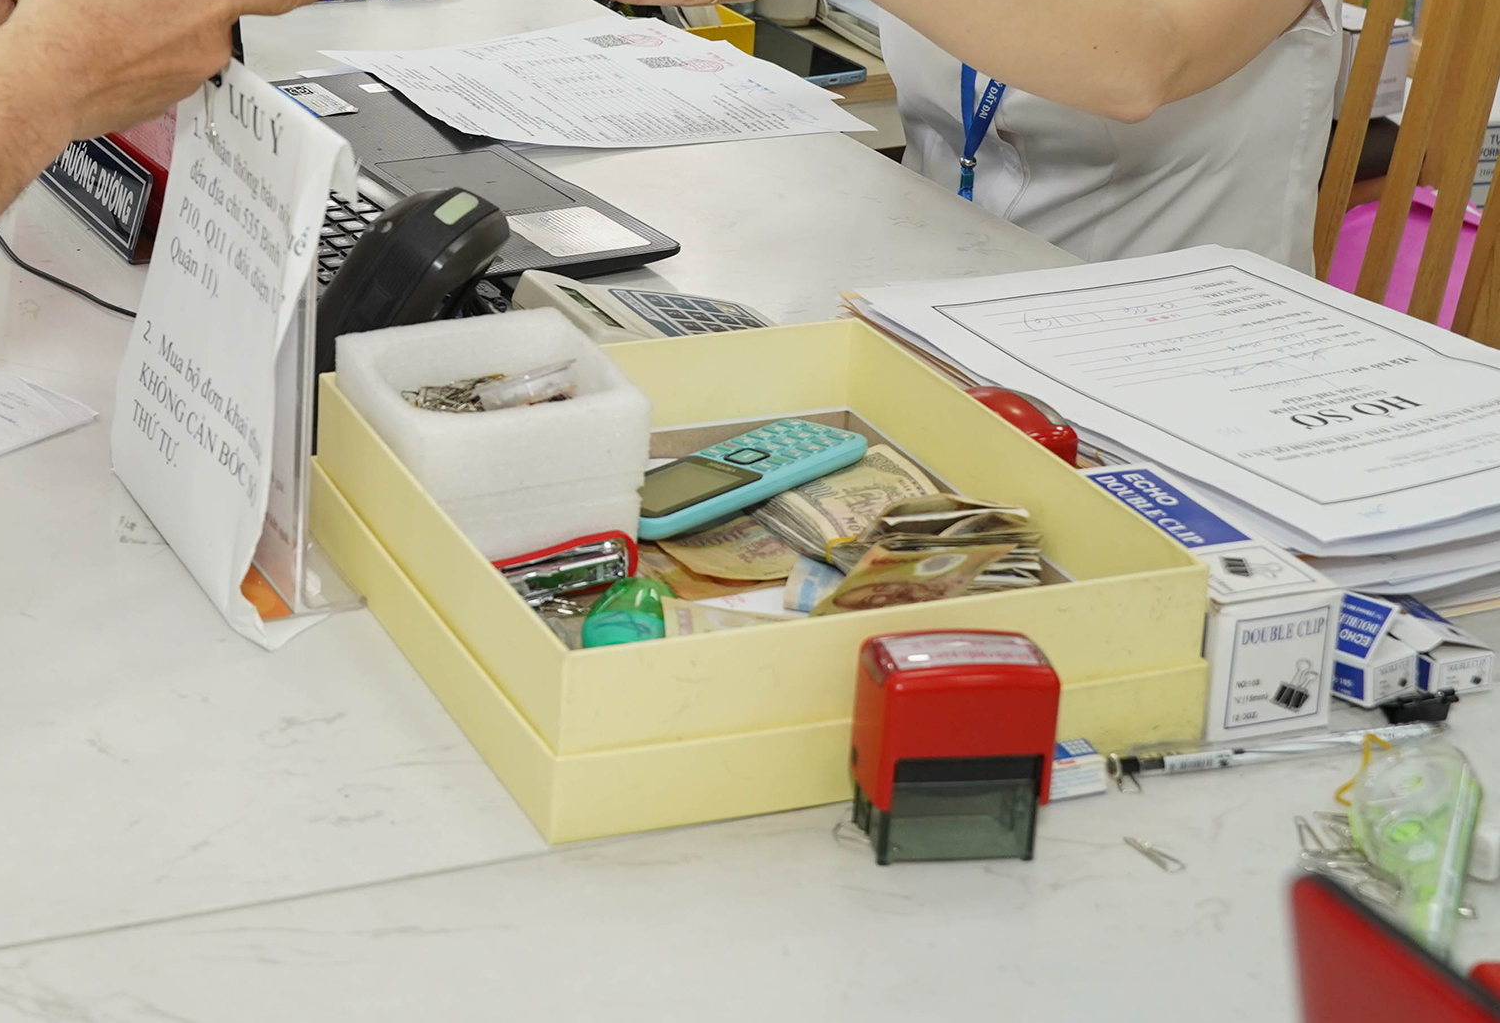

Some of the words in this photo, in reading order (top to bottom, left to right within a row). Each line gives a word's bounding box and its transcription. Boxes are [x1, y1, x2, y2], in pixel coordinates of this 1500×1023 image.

[228, 82, 265, 141] LƯU
[270, 112, 284, 155] Ý
[94, 168, 134, 225] DƯƠNG
[179, 196, 201, 237] P10,
[204, 219, 227, 254] Q11
[190, 158, 207, 191] đến
[207, 176, 225, 207] địa
[243, 206, 260, 240] 535
[170, 236, 199, 278] Quận
[200, 263, 220, 299] 11).
[138, 361, 187, 424] KHÔNG
[142, 320, 152, 345] 2.
[158, 334, 184, 375] Mua
[185, 358, 201, 393] bộ
[200, 377, 224, 414] đơn
[132, 399, 161, 441] THỨ
[158, 428, 181, 468] TỰ.
[1290, 408, 1353, 430] SƠ
[1350, 395, 1424, 419] HỒ
[1095, 475, 1168, 521] DOUBLE
[1157, 515, 1206, 545] CLIP
[1121, 473, 1180, 507] ECHO
[1241, 622, 1294, 646] DOUBLE
[1296, 616, 1326, 638] CLIP
[1339, 628, 1373, 648] ECHO
